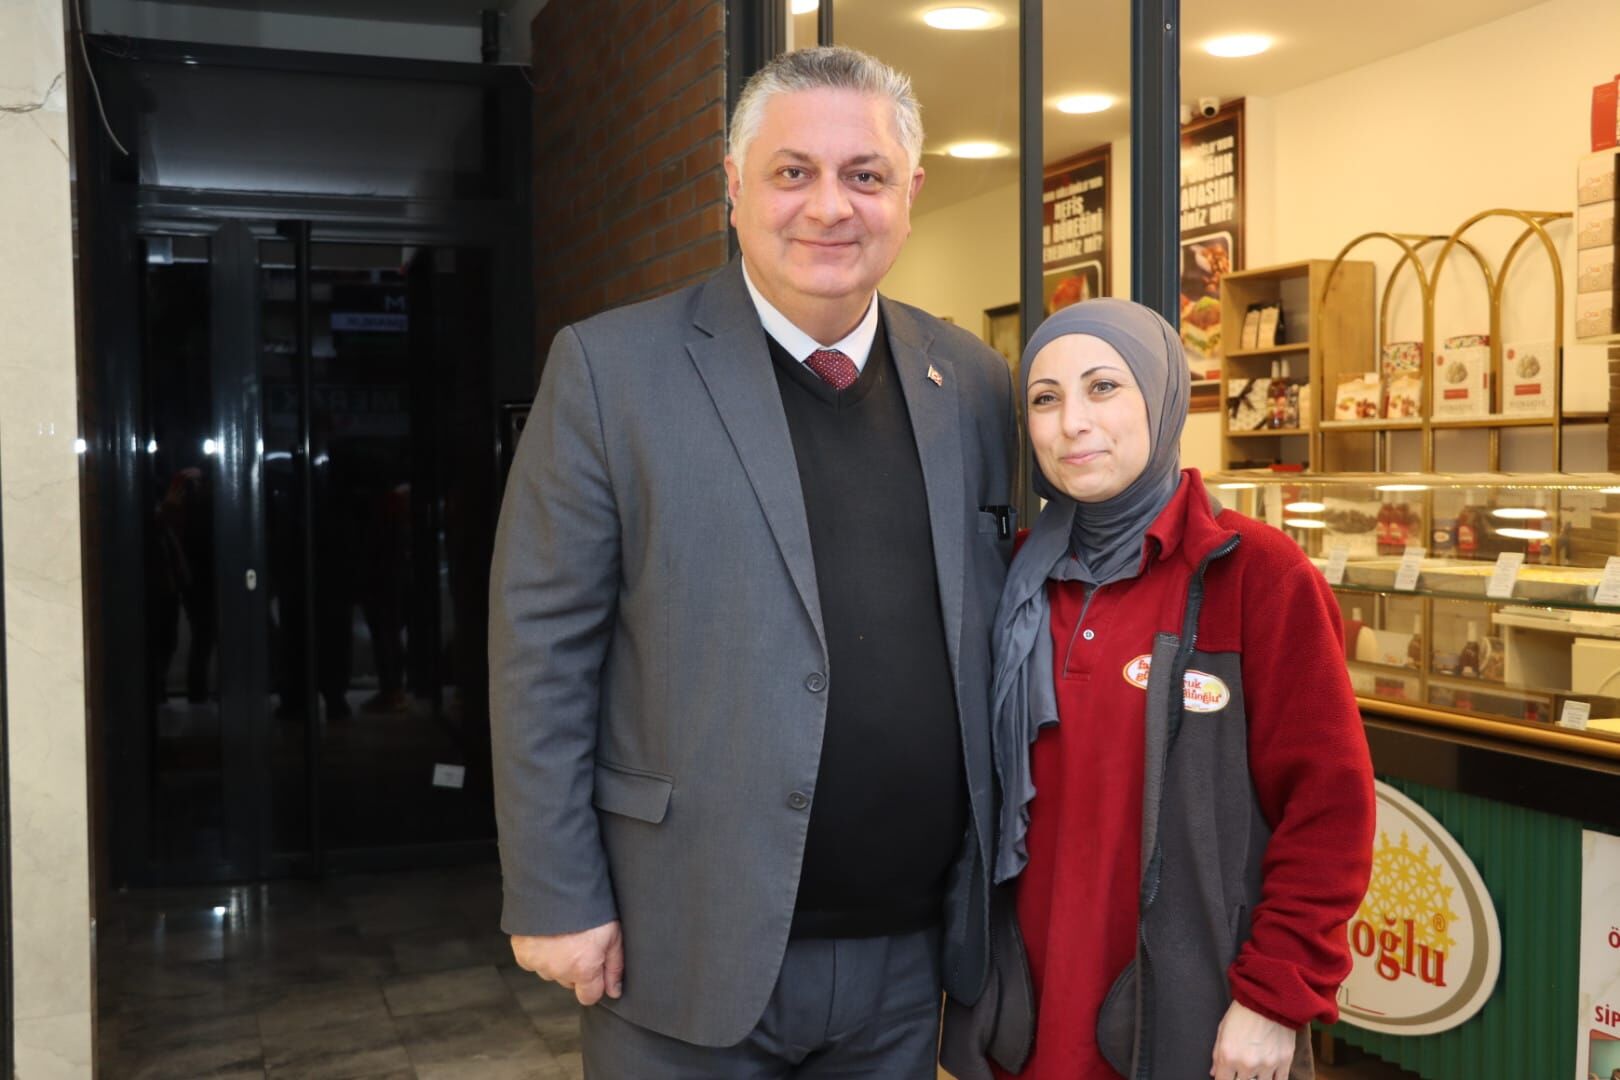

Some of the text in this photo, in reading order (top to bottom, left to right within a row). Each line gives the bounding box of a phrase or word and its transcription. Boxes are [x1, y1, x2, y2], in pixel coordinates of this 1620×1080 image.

[1608, 926, 1620, 948] Ö
[1352, 913, 1447, 987] oğlu
[1594, 1003, 1620, 1028] SİP
